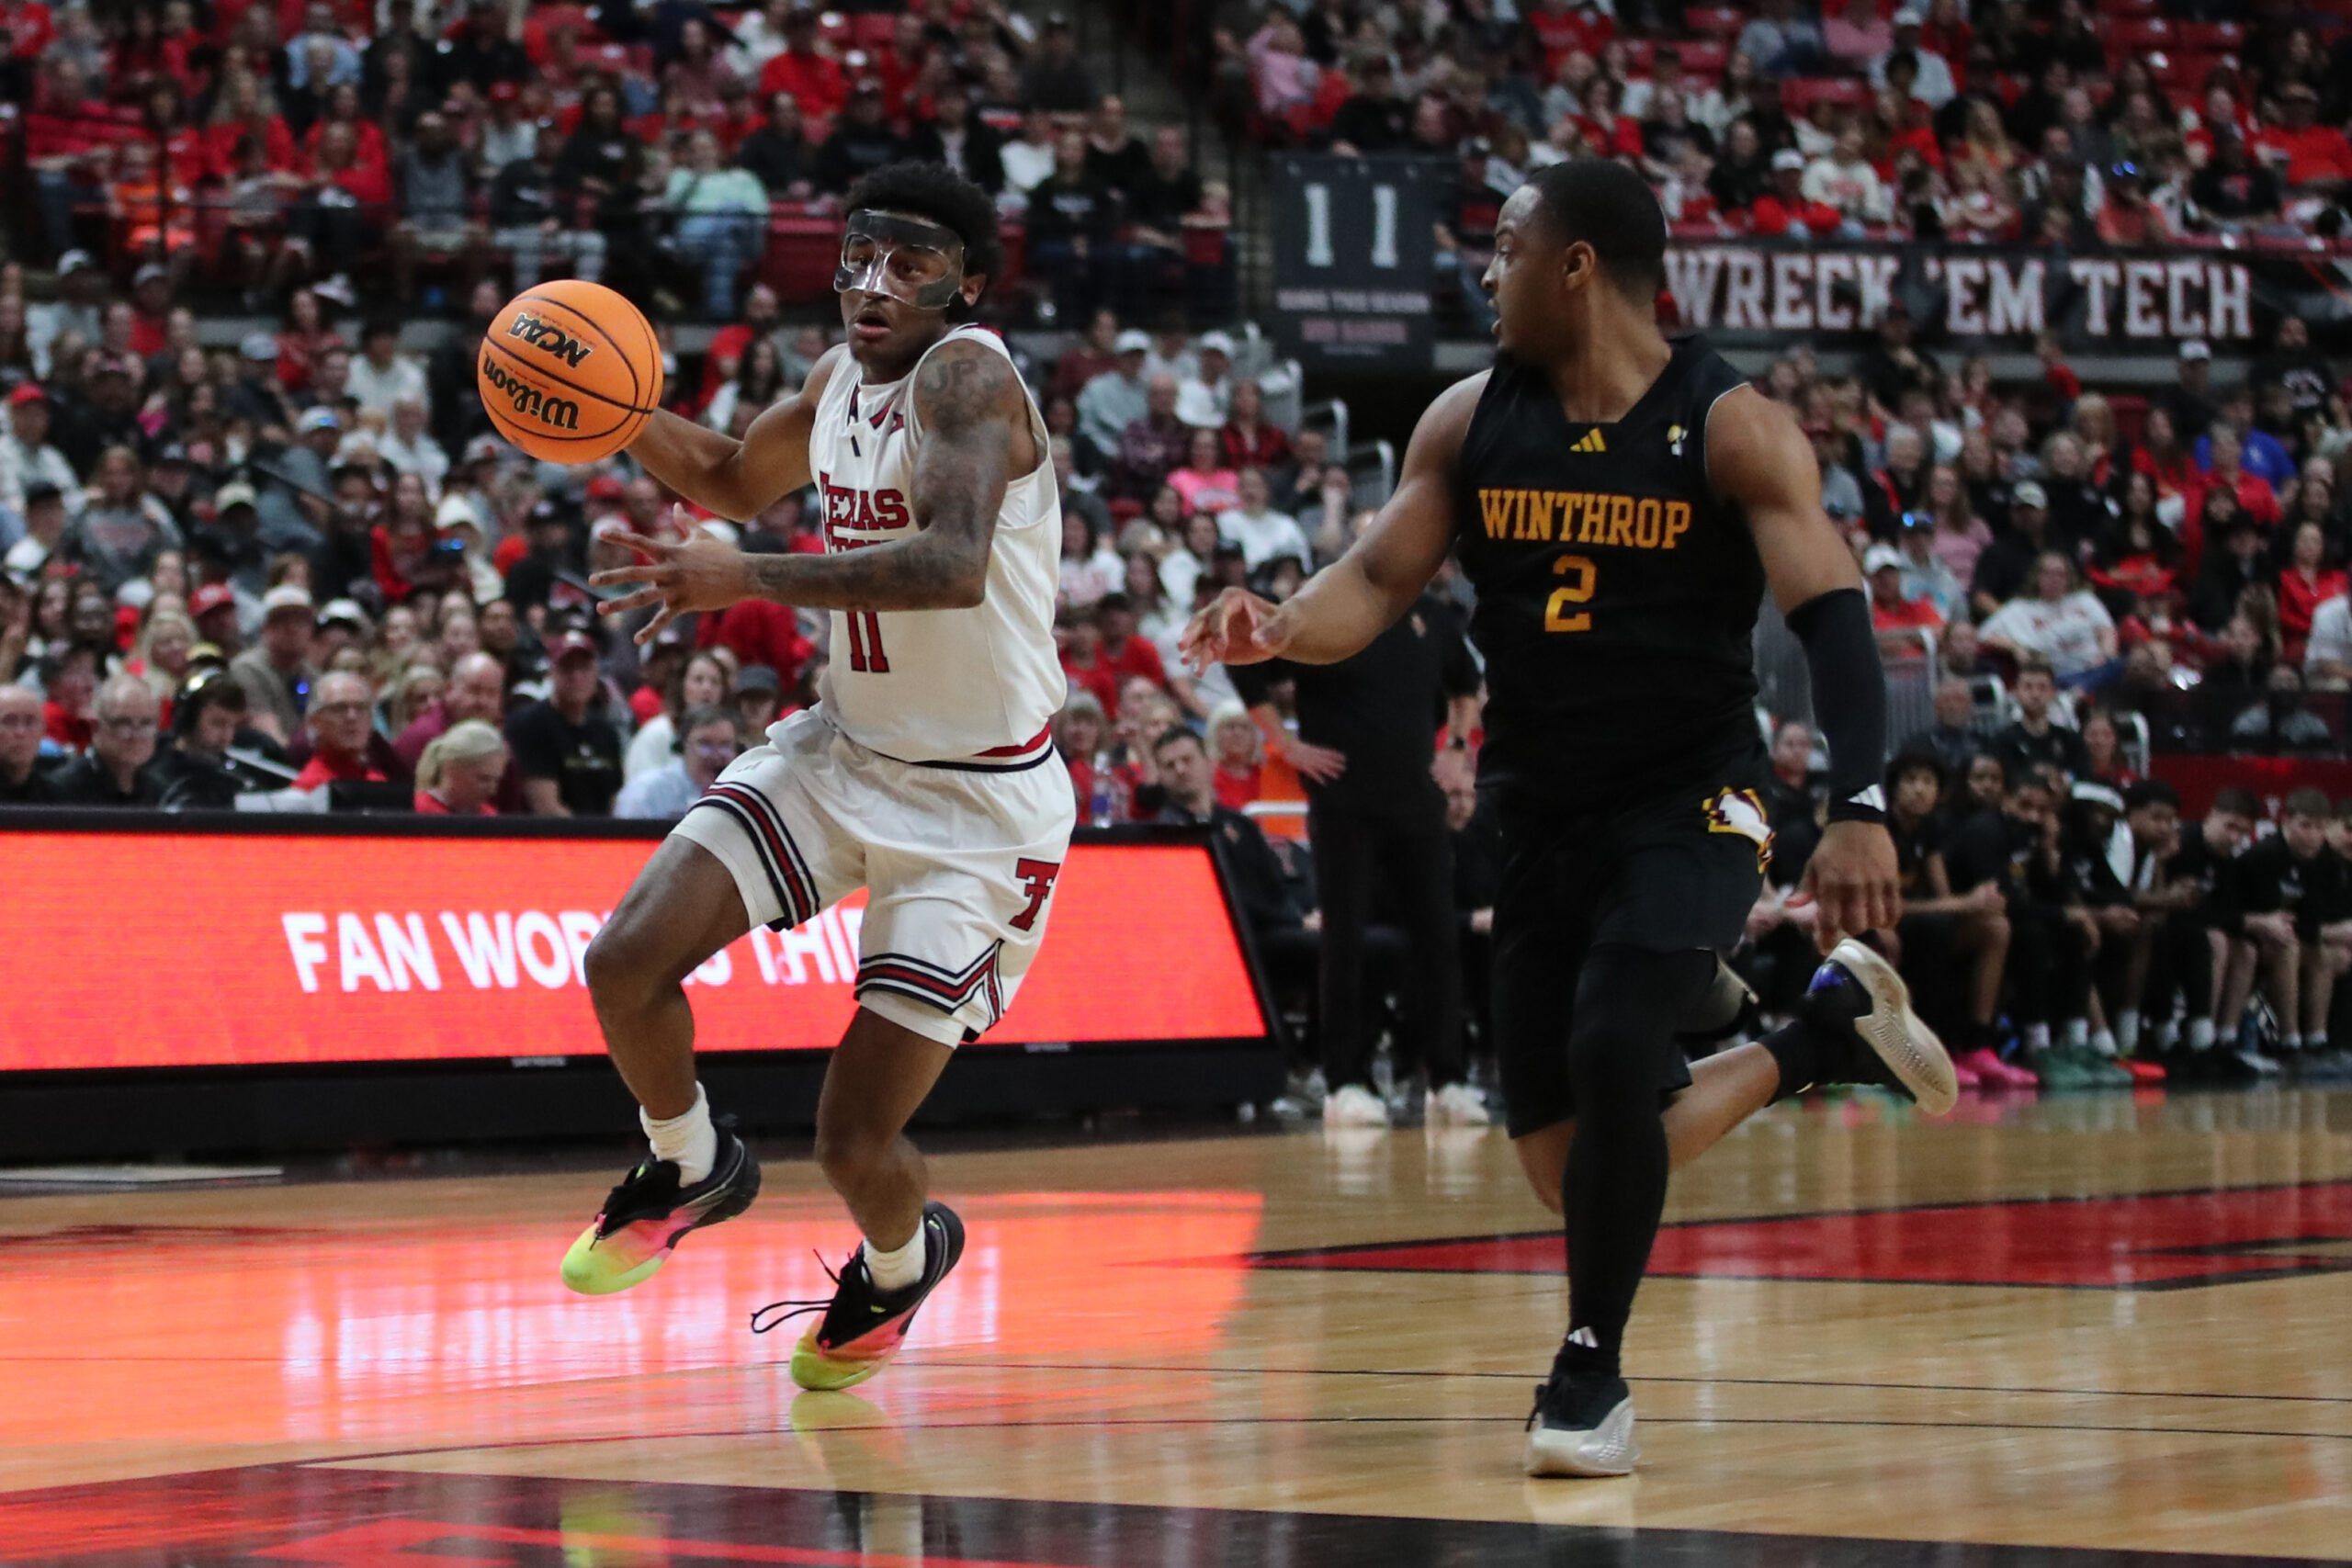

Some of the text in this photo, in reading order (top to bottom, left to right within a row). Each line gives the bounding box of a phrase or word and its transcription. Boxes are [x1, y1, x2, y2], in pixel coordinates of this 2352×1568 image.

[1663, 249, 1899, 330] WRECK
[2069, 259, 2253, 339] TECH
[507, 311, 595, 371] NCAA
[482, 349, 580, 431] Wilson
[1477, 488, 1692, 550] WINTHROP
[1544, 554, 1598, 633] 2
[845, 609, 890, 673] 11
[280, 911, 442, 993] FAN
